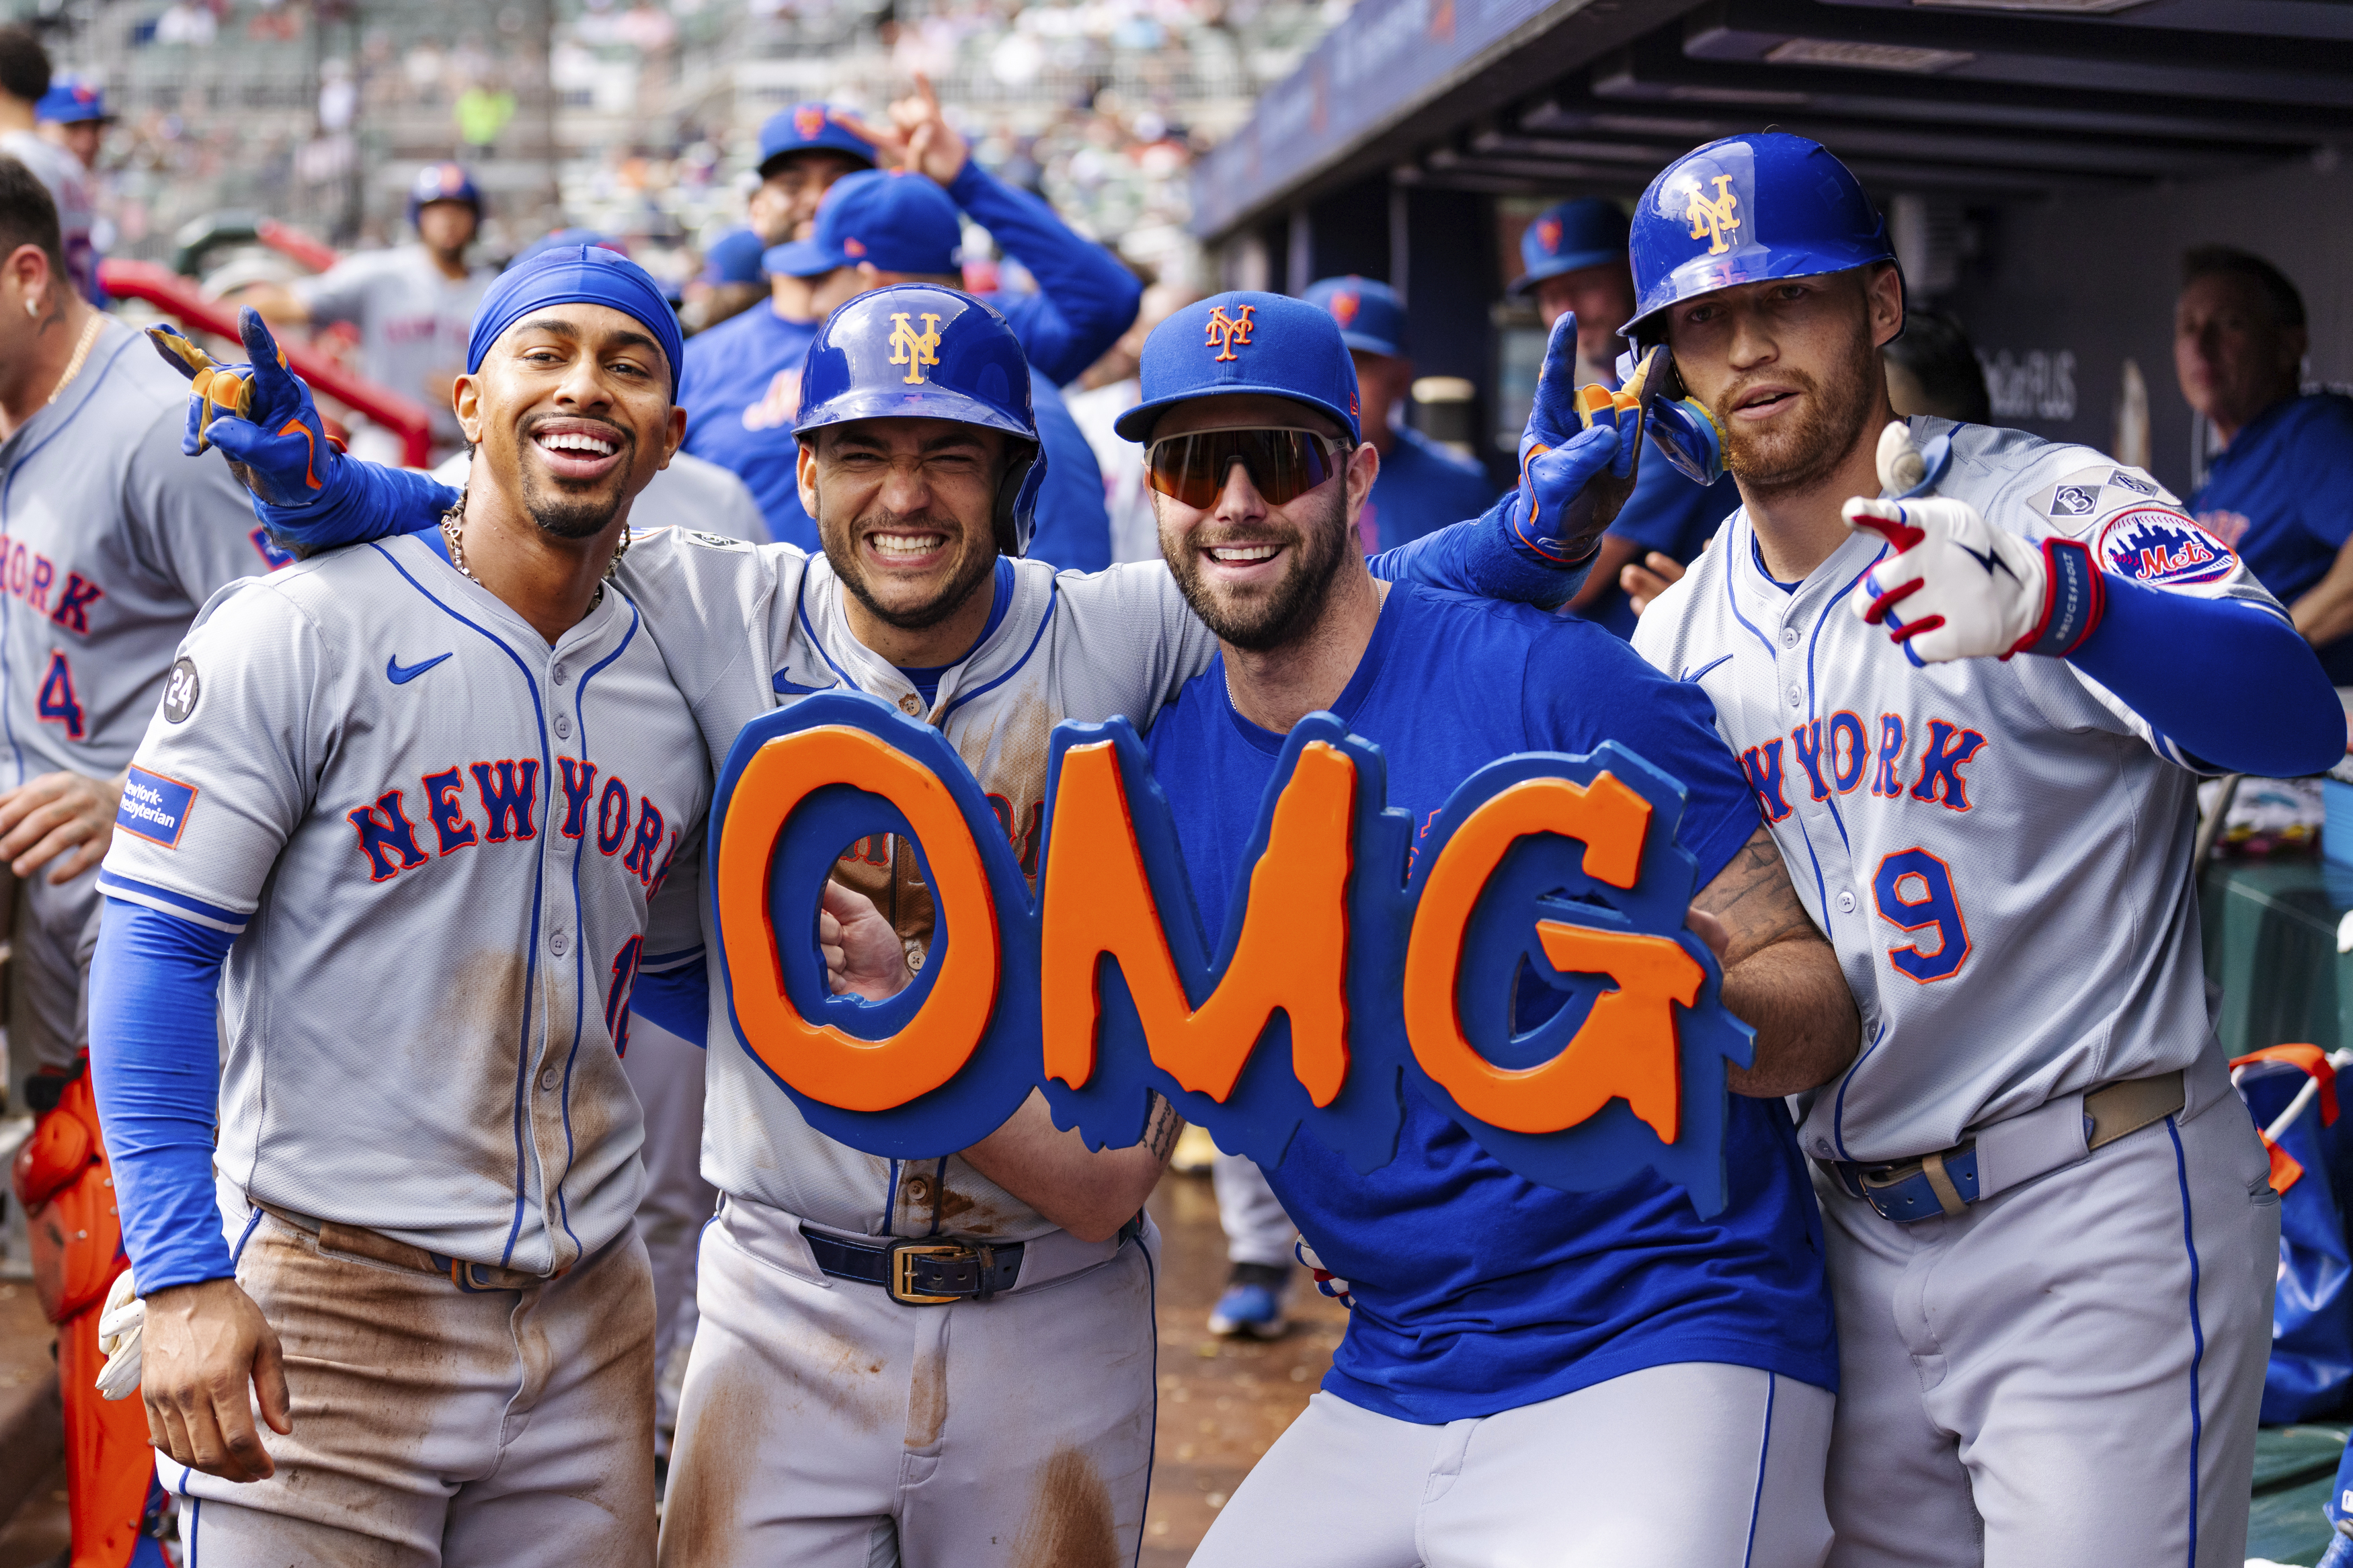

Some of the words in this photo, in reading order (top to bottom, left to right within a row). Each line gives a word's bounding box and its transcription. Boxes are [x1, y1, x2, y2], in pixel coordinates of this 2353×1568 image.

[2135, 540, 2214, 580] Mets
[34, 649, 85, 740] 4
[166, 669, 195, 713] 24
[1791, 710, 1988, 812] YORK
[120, 794, 175, 828] Presbyterian
[346, 757, 540, 882] NEW
[717, 724, 1706, 1145] OMG
[1871, 846, 1972, 985] 9
